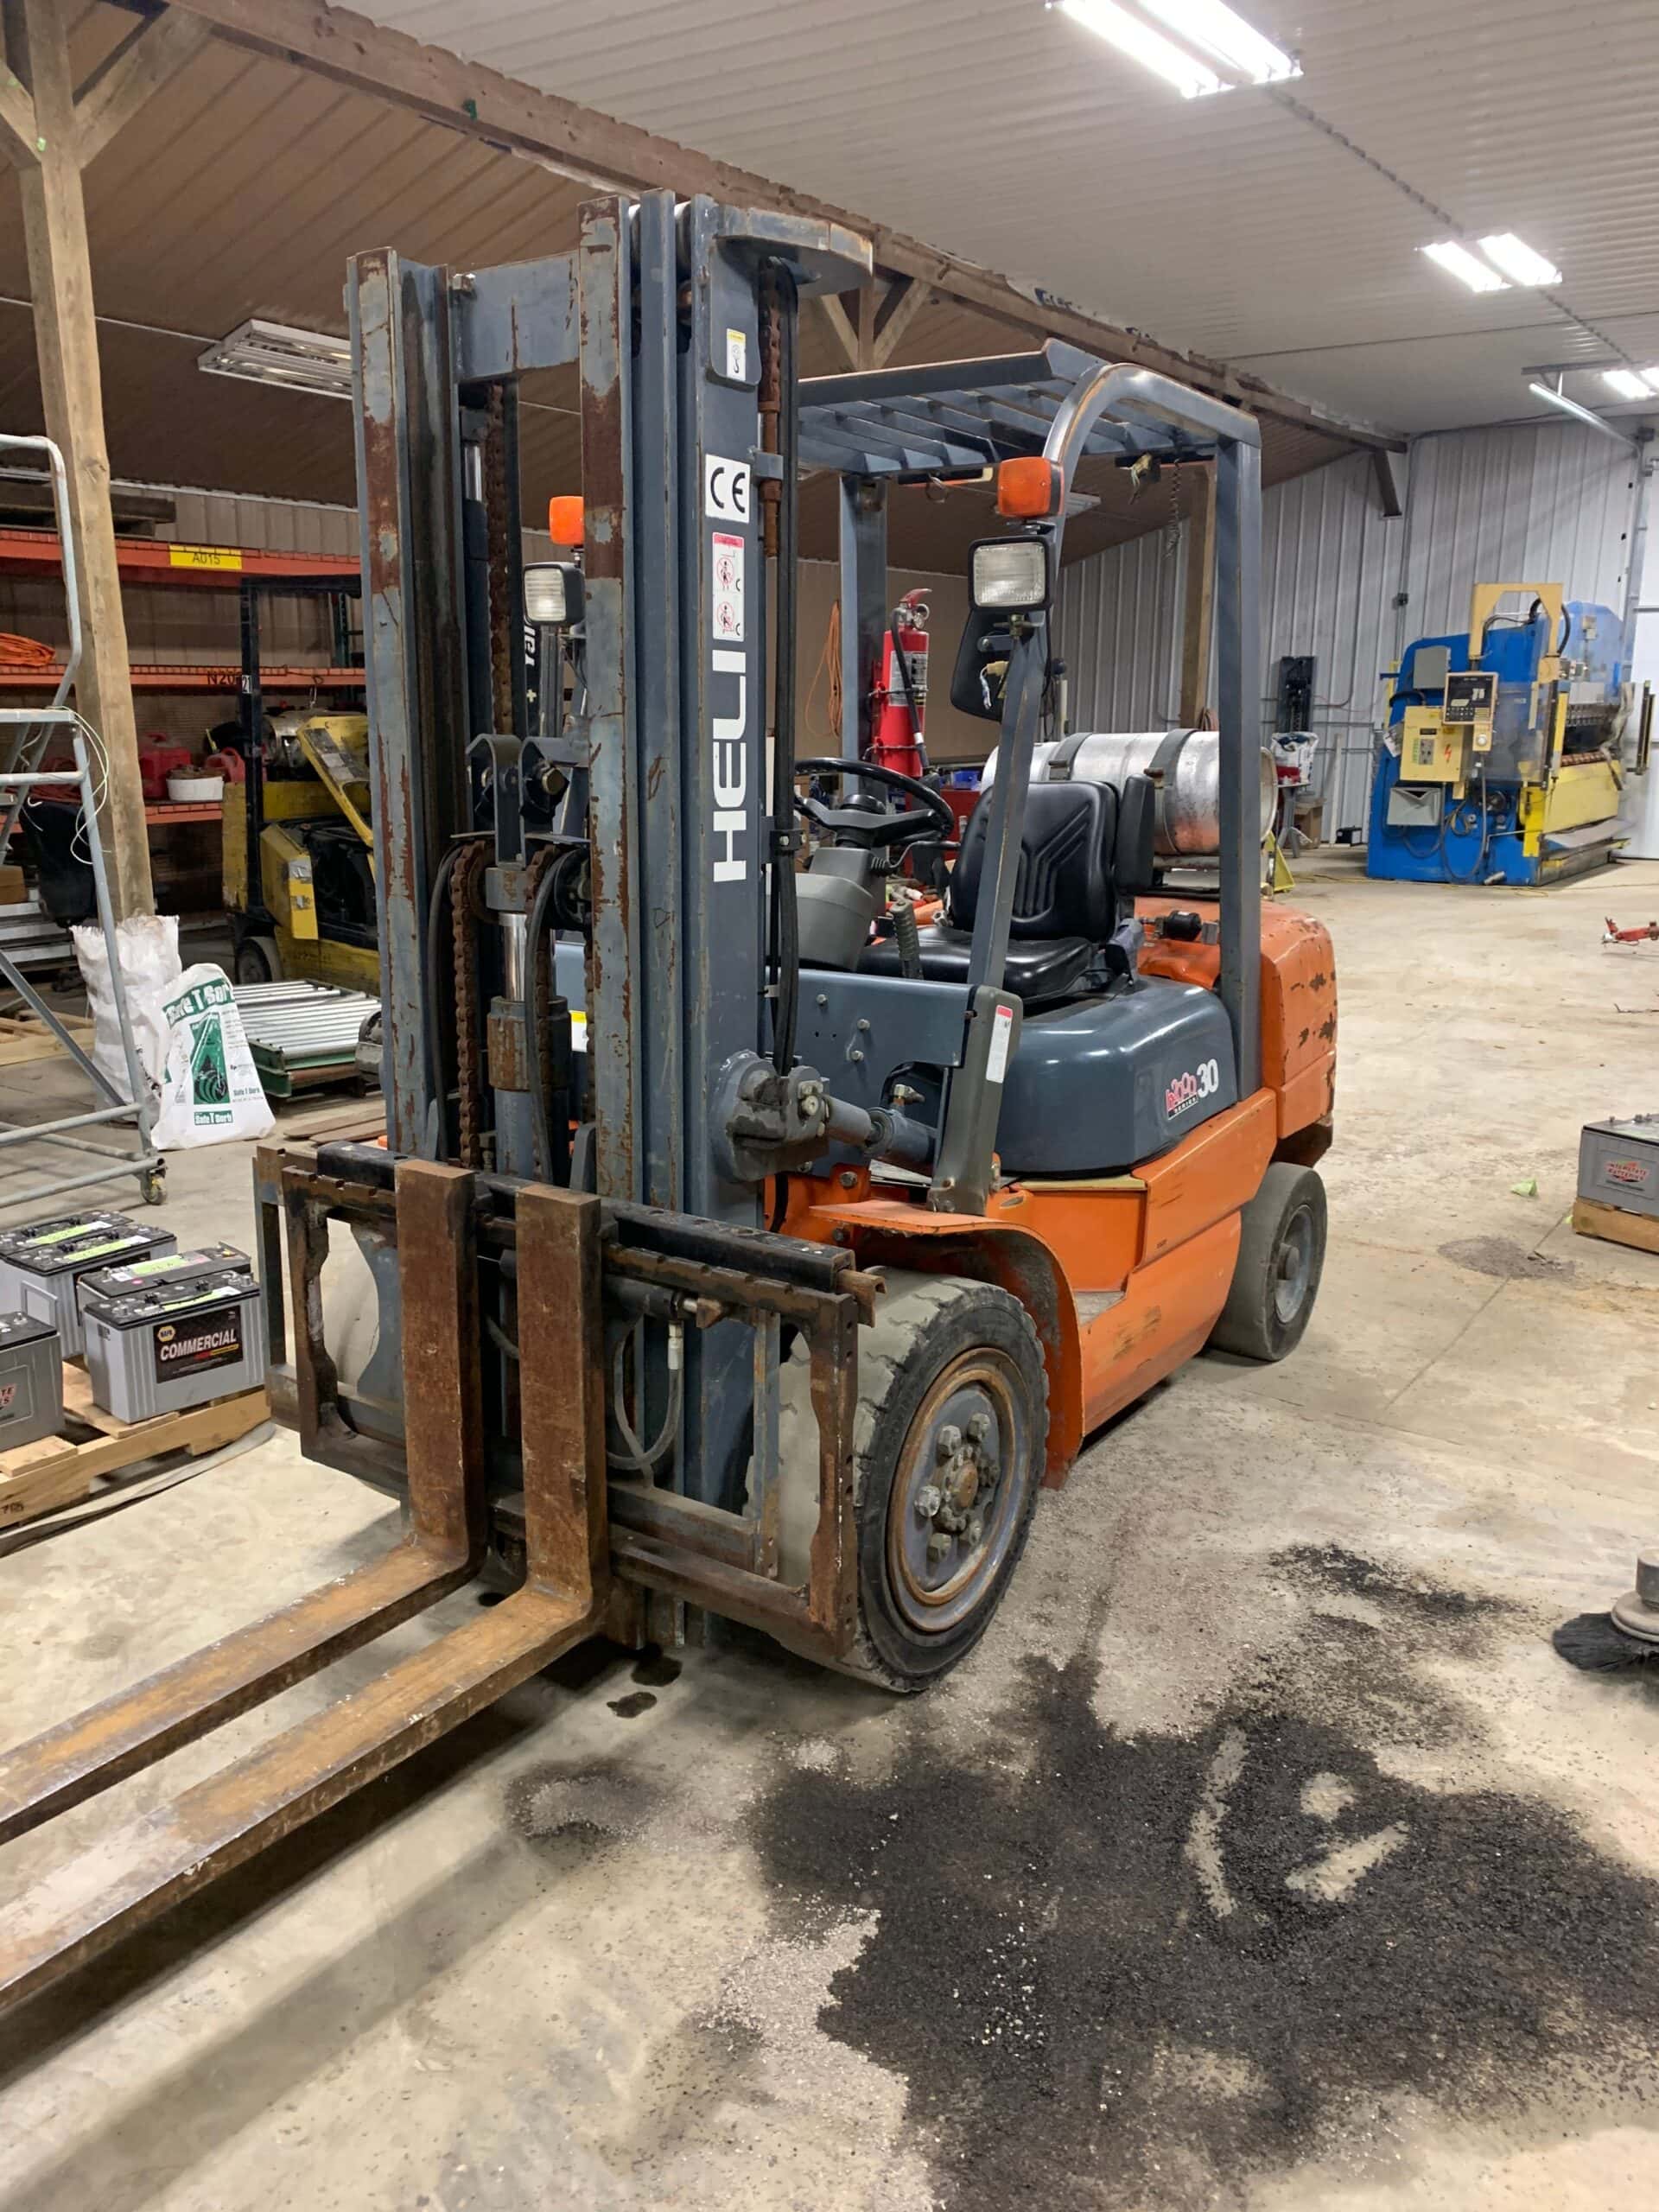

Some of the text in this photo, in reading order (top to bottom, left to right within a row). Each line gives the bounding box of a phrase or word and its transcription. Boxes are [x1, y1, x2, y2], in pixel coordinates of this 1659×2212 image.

[709, 466, 747, 514] CE
[712, 649, 747, 883] HELI
[191, 988, 205, 1010] T
[1196, 1058, 1219, 1098] 30
[160, 1328, 237, 1362] COMMERCIAL
